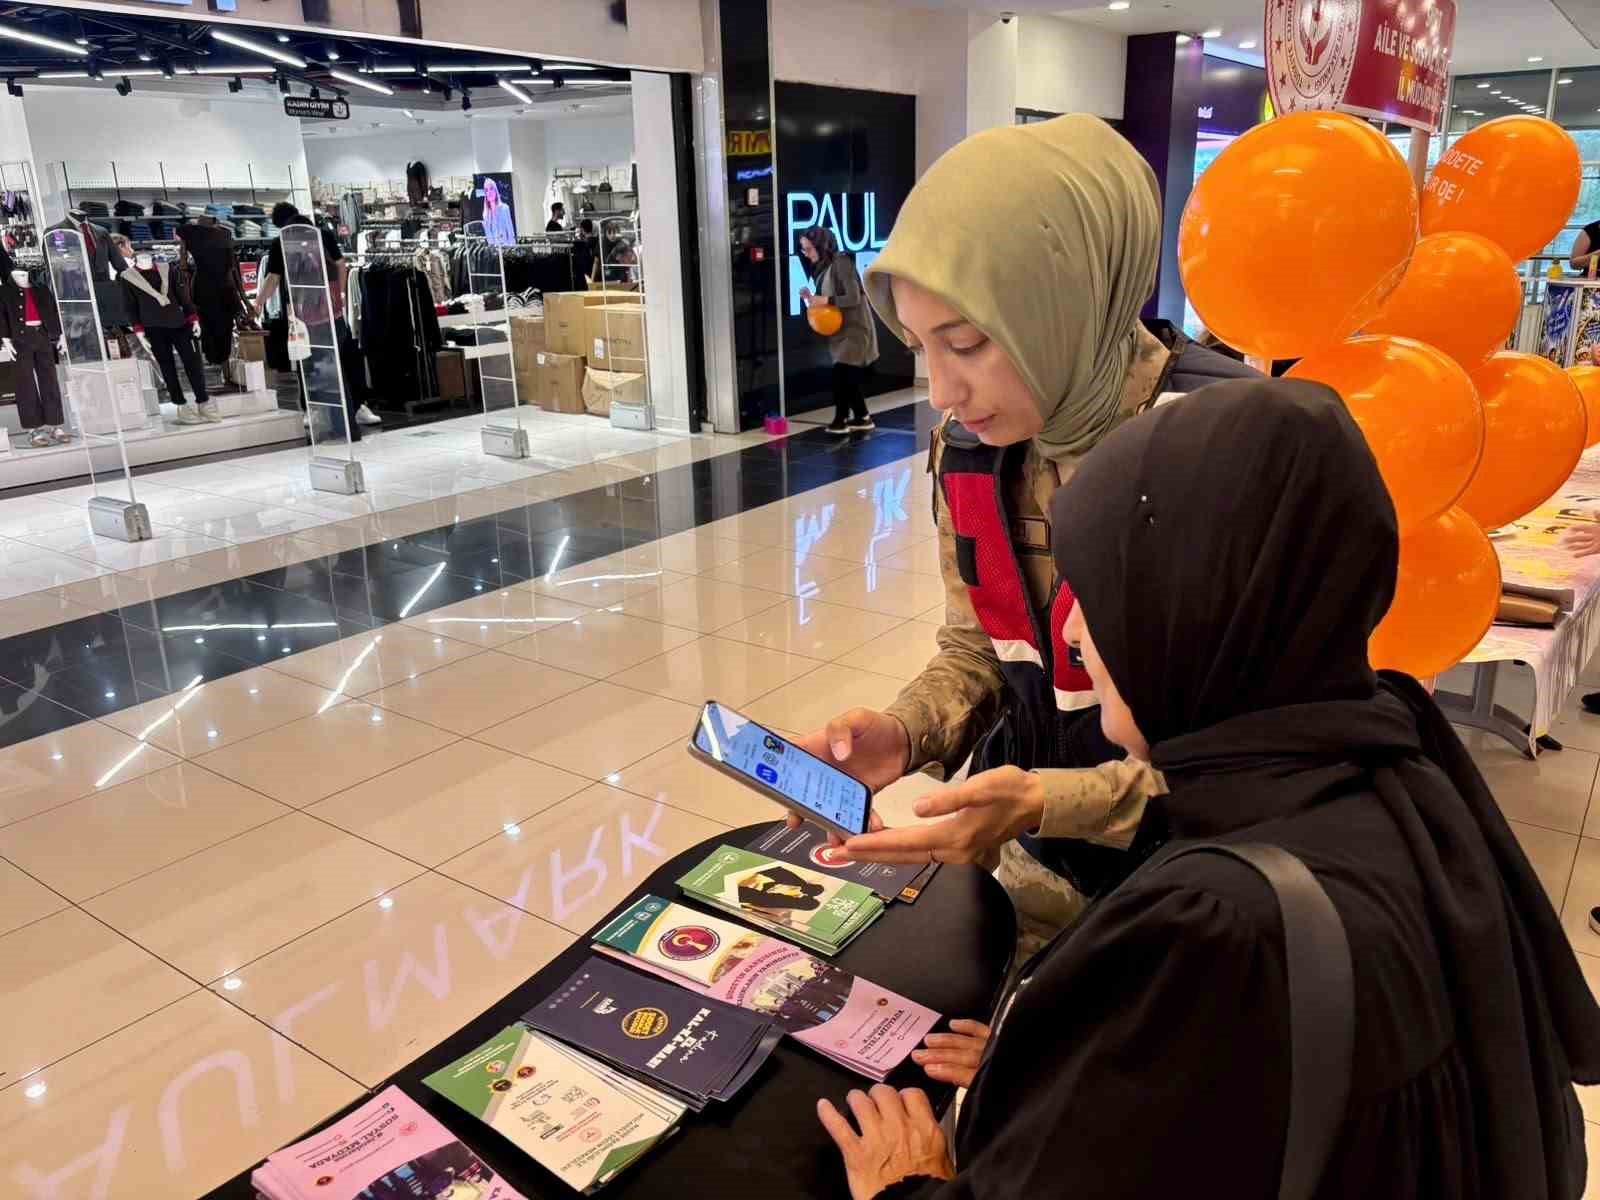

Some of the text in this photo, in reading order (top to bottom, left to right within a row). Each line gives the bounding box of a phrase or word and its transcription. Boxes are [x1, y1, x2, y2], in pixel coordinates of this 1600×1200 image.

[1373, 20, 1398, 57] AİLE
[1398, 31, 1411, 61] VE
[787, 191, 888, 255] PAUL
[361, 1113, 399, 1142] SOSYAL
[308, 1139, 362, 1169] MEDYADA
